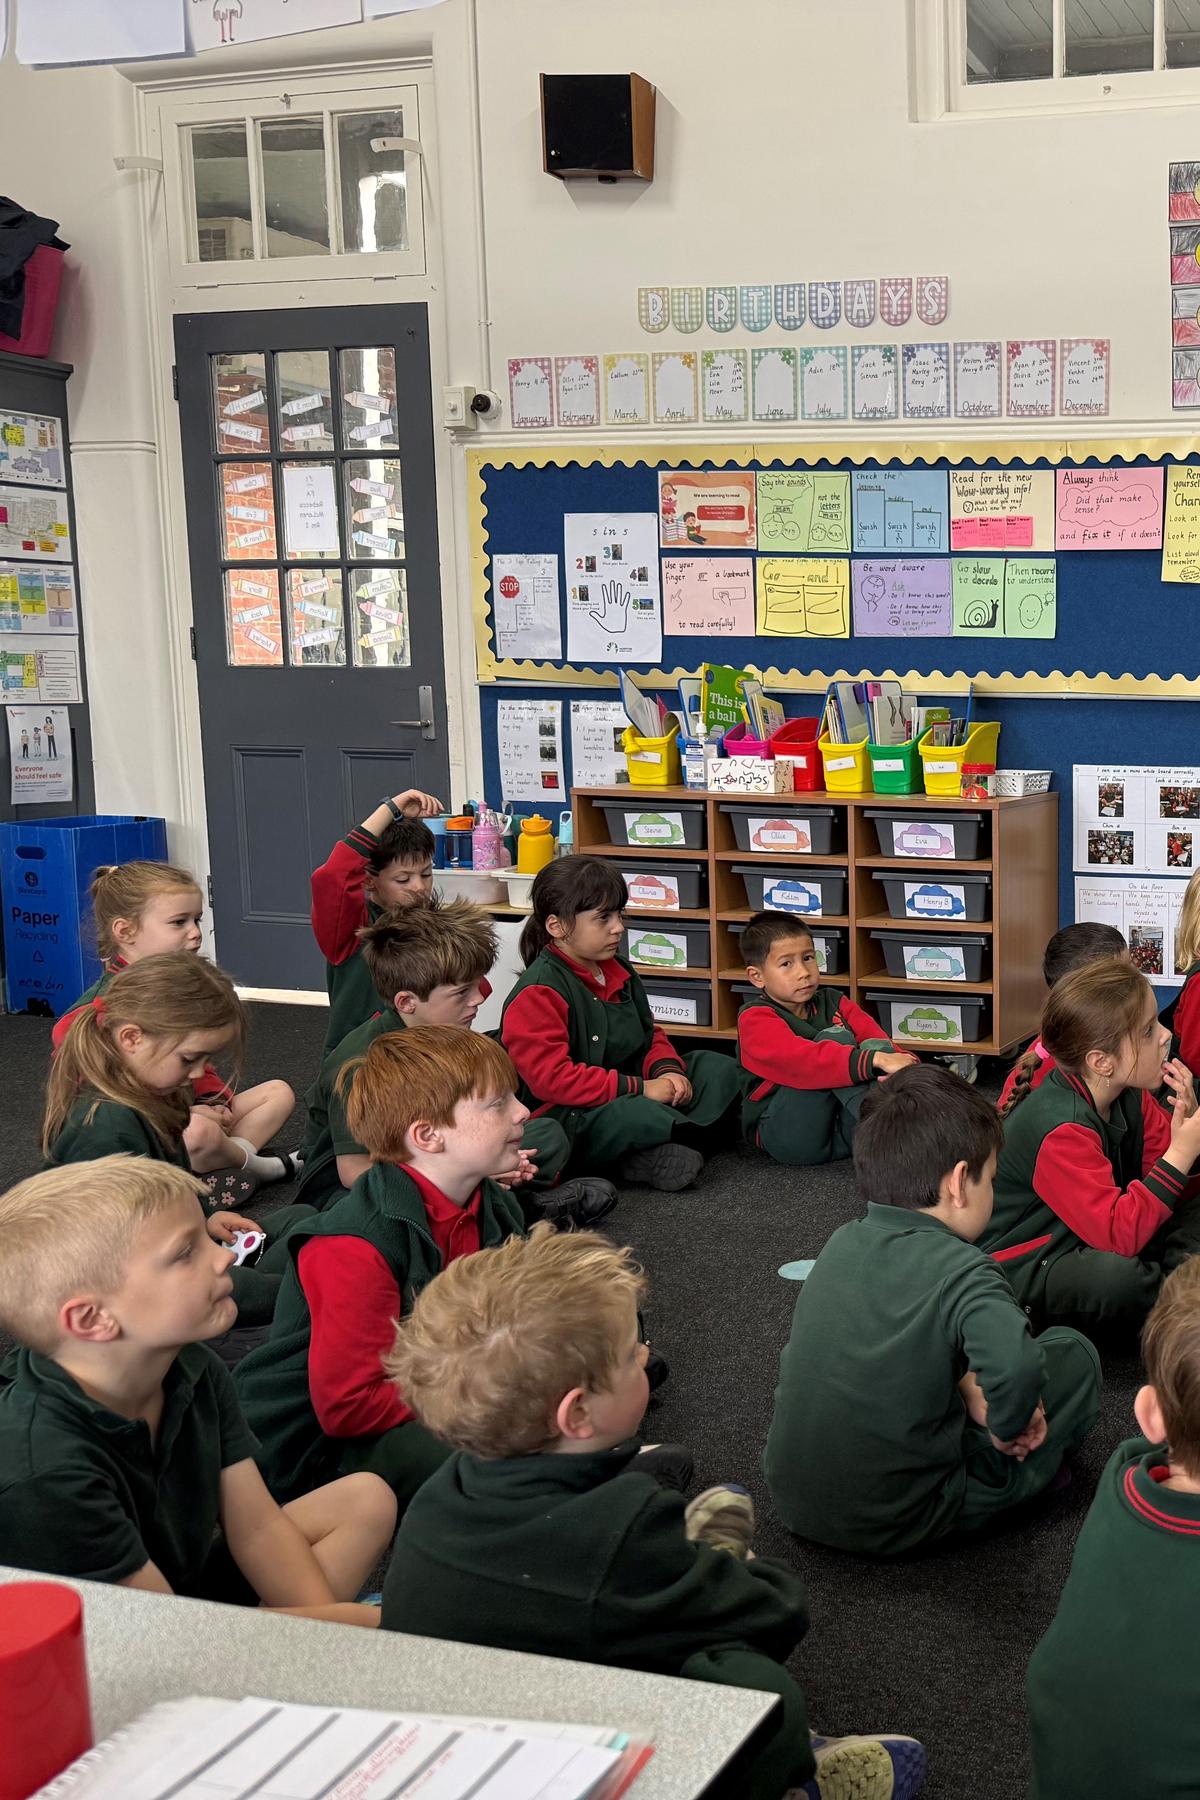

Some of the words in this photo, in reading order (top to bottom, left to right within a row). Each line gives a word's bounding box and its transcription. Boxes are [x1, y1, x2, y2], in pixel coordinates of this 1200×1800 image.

[648, 280, 942, 327] BIRTHDAYS
[816, 404, 832, 416] July
[860, 402, 888, 414] August
[906, 402, 946, 414] September
[962, 401, 992, 412] October
[1010, 400, 1050, 410] November
[1064, 399, 1103, 410] December
[562, 410, 594, 423] February
[614, 408, 638, 419] March
[665, 408, 685, 418] April
[716, 406, 732, 418] May
[765, 406, 784, 416] June
[515, 412, 548, 425] January
[761, 478, 773, 490] Say
[777, 478, 785, 486] the
[787, 478, 806, 487] sounds
[952, 473, 974, 483] Read
[980, 473, 992, 484] for
[999, 473, 1011, 483] the
[1062, 472, 1093, 488] Always
[1099, 472, 1119, 482] think
[956, 485, 1009, 497] Wow-worthy
[1013, 484, 1032, 497] info!
[830, 493, 841, 501] the
[1076, 496, 1091, 504] Did
[1096, 495, 1114, 503] that
[1075, 505, 1100, 514] sense?
[1169, 514, 1186, 522] Look
[593, 528, 598, 536] 5
[603, 527, 617, 535] in
[622, 527, 628, 535] 5
[1060, 531, 1076, 539] and
[1082, 530, 1098, 544] fix
[1103, 530, 1111, 539] it
[1118, 530, 1127, 541] if
[1130, 530, 1137, 538] it
[1139, 528, 1161, 538] doesn't
[1188, 531, 1197, 542] for
[679, 562, 694, 573] your
[863, 564, 872, 572] Be
[880, 564, 896, 572] word
[902, 564, 925, 572] aware
[958, 563, 969, 573] Go
[972, 562, 991, 574] slow
[1009, 563, 1029, 576] Then
[665, 573, 686, 584] finger
[959, 577, 968, 585] to
[1007, 577, 1015, 585] to
[1019, 576, 1054, 585] understand
[500, 583, 519, 592] STOP
[707, 617, 736, 630] carefully!
[710, 692, 733, 707] This
[709, 711, 716, 719] a
[718, 709, 736, 722] ball
[12, 906, 60, 928] Paper
[15, 929, 58, 944] Recycling
